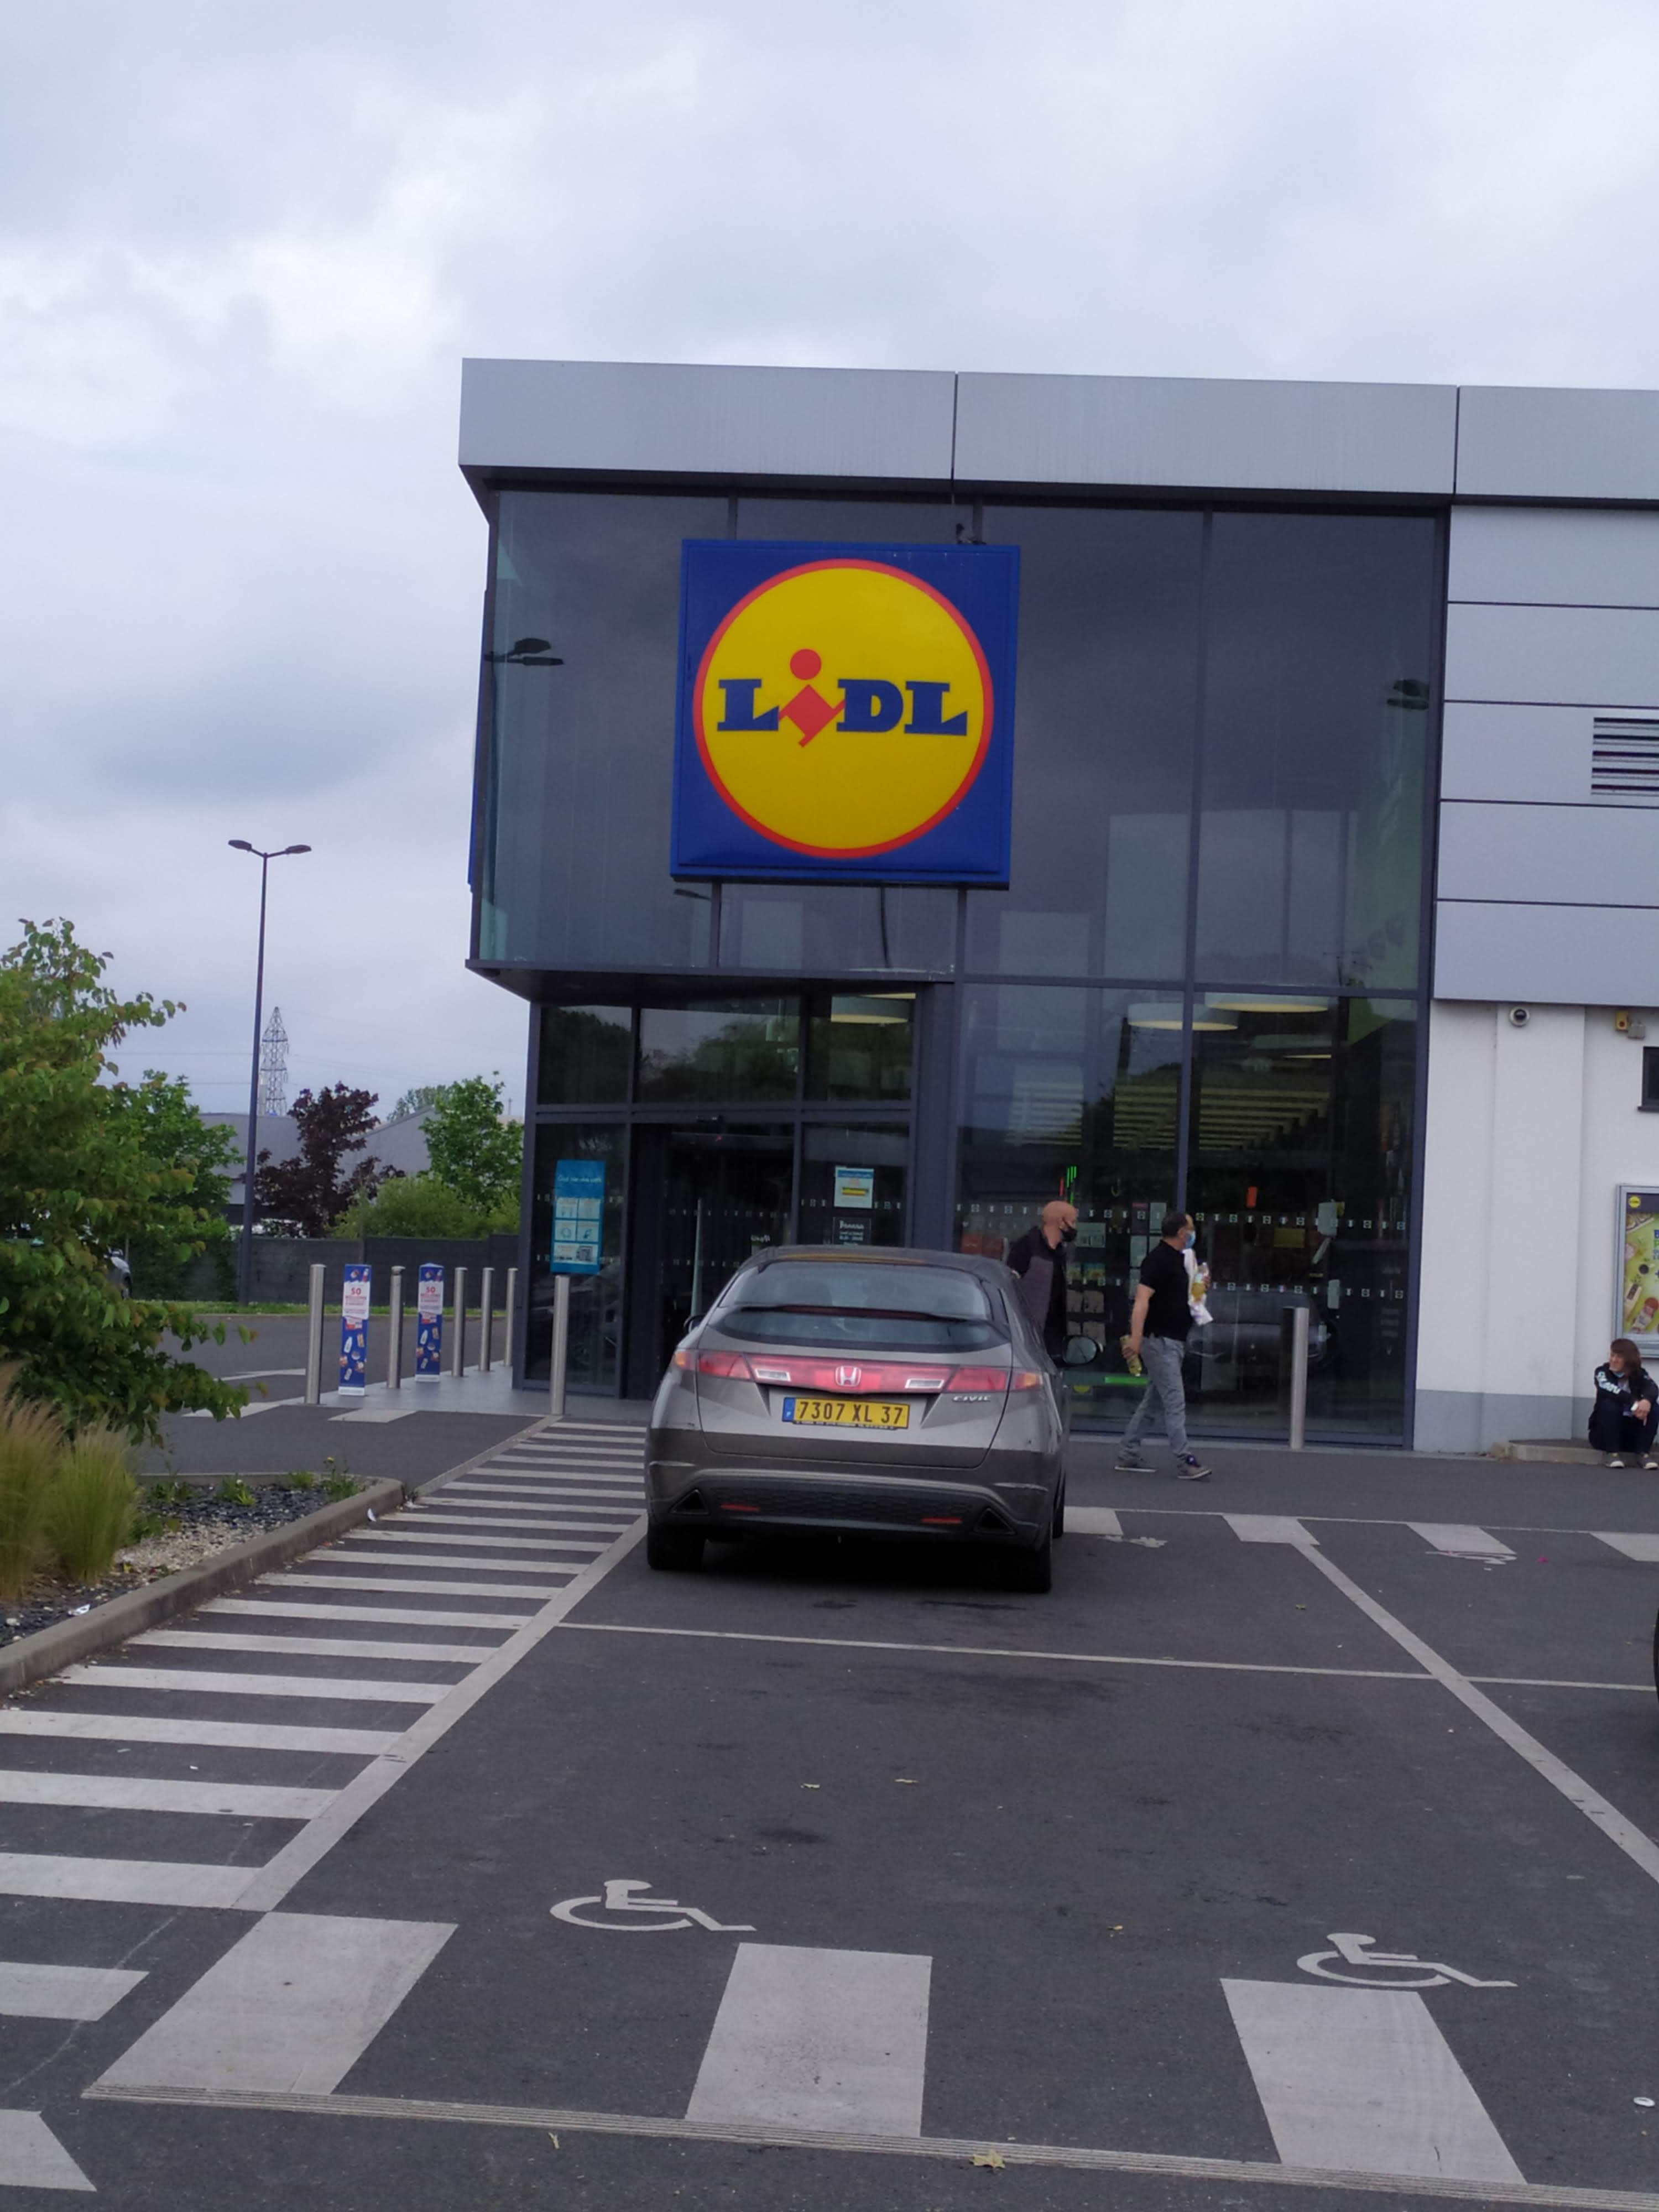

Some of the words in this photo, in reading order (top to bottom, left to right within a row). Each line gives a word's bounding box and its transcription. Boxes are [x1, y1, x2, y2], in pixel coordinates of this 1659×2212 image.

[351, 1286, 361, 1295] 50
[799, 1401, 846, 1421] 7307
[852, 1404, 872, 1422] XL
[881, 1406, 903, 1425] 37
